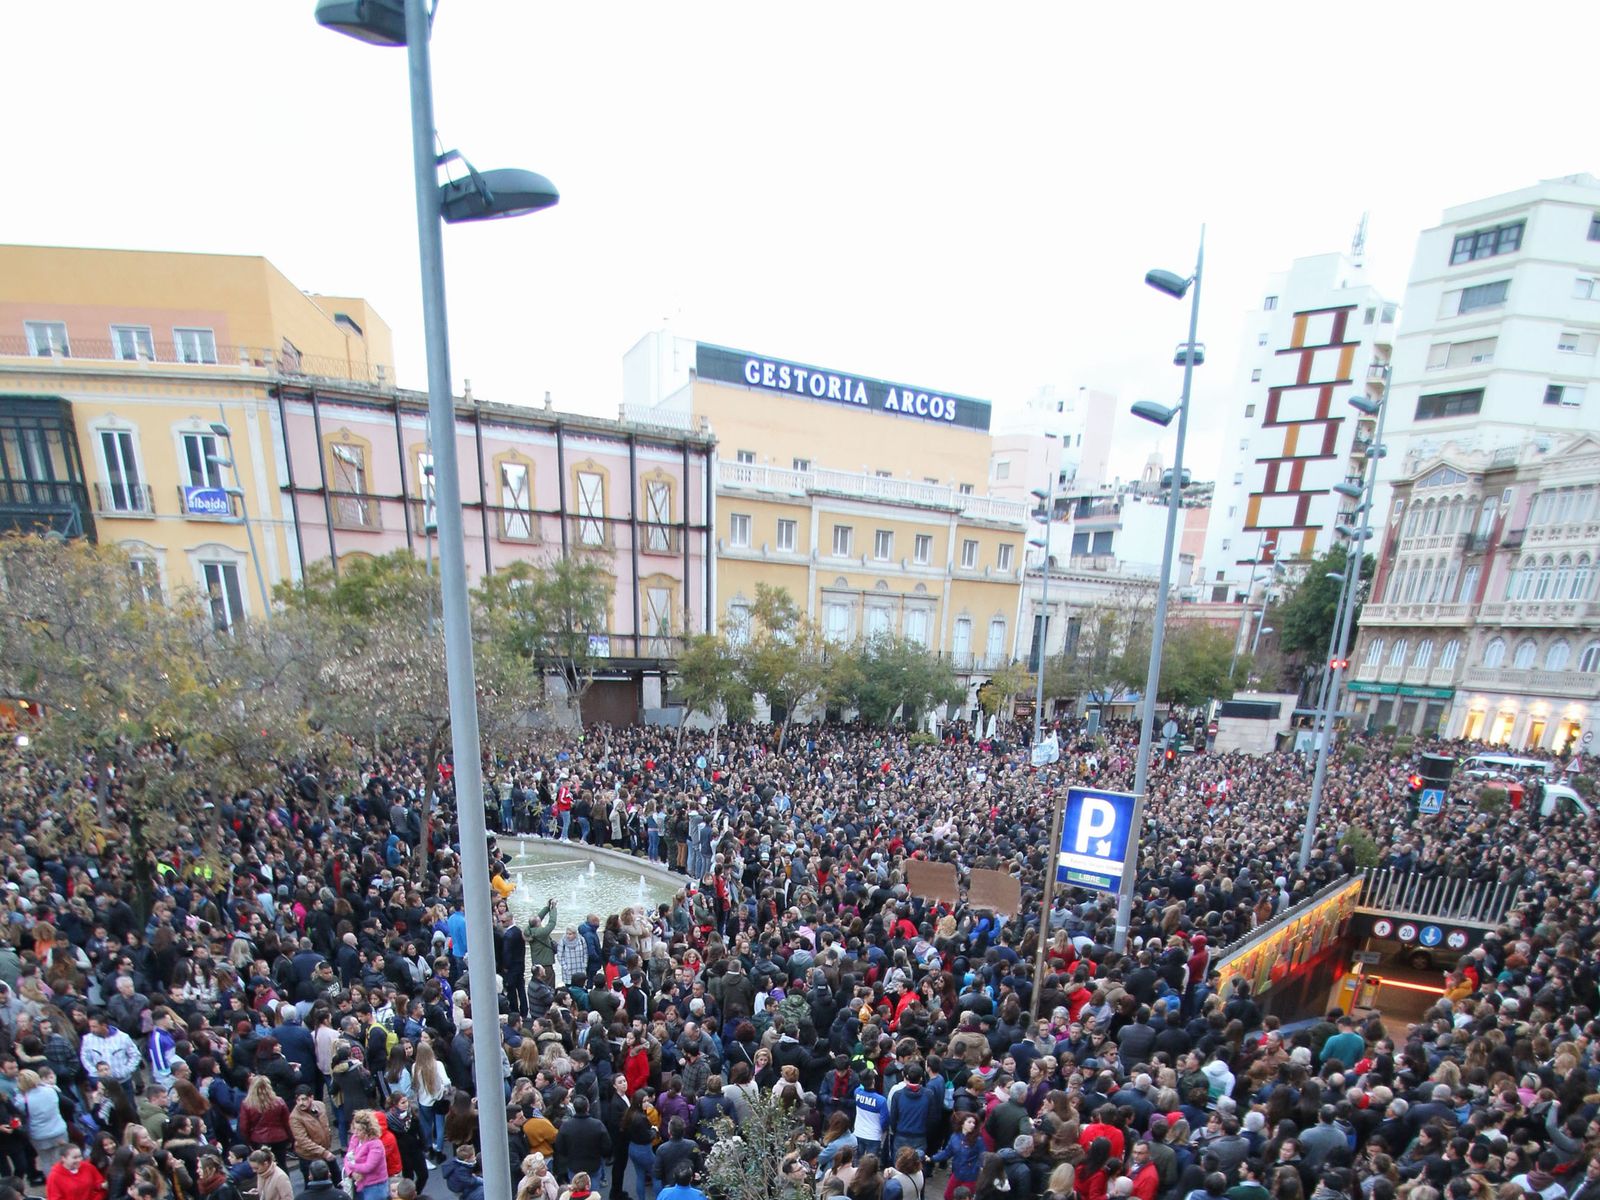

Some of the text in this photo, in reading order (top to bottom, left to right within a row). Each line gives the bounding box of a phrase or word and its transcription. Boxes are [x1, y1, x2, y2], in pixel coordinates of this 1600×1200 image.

[744, 359, 956, 421] GESTORIA ARCOS
[1075, 797, 1117, 854] P
[1078, 872, 1101, 884] LIBRE
[1402, 927, 1413, 938] 20
[855, 1093, 877, 1108] PUMA
